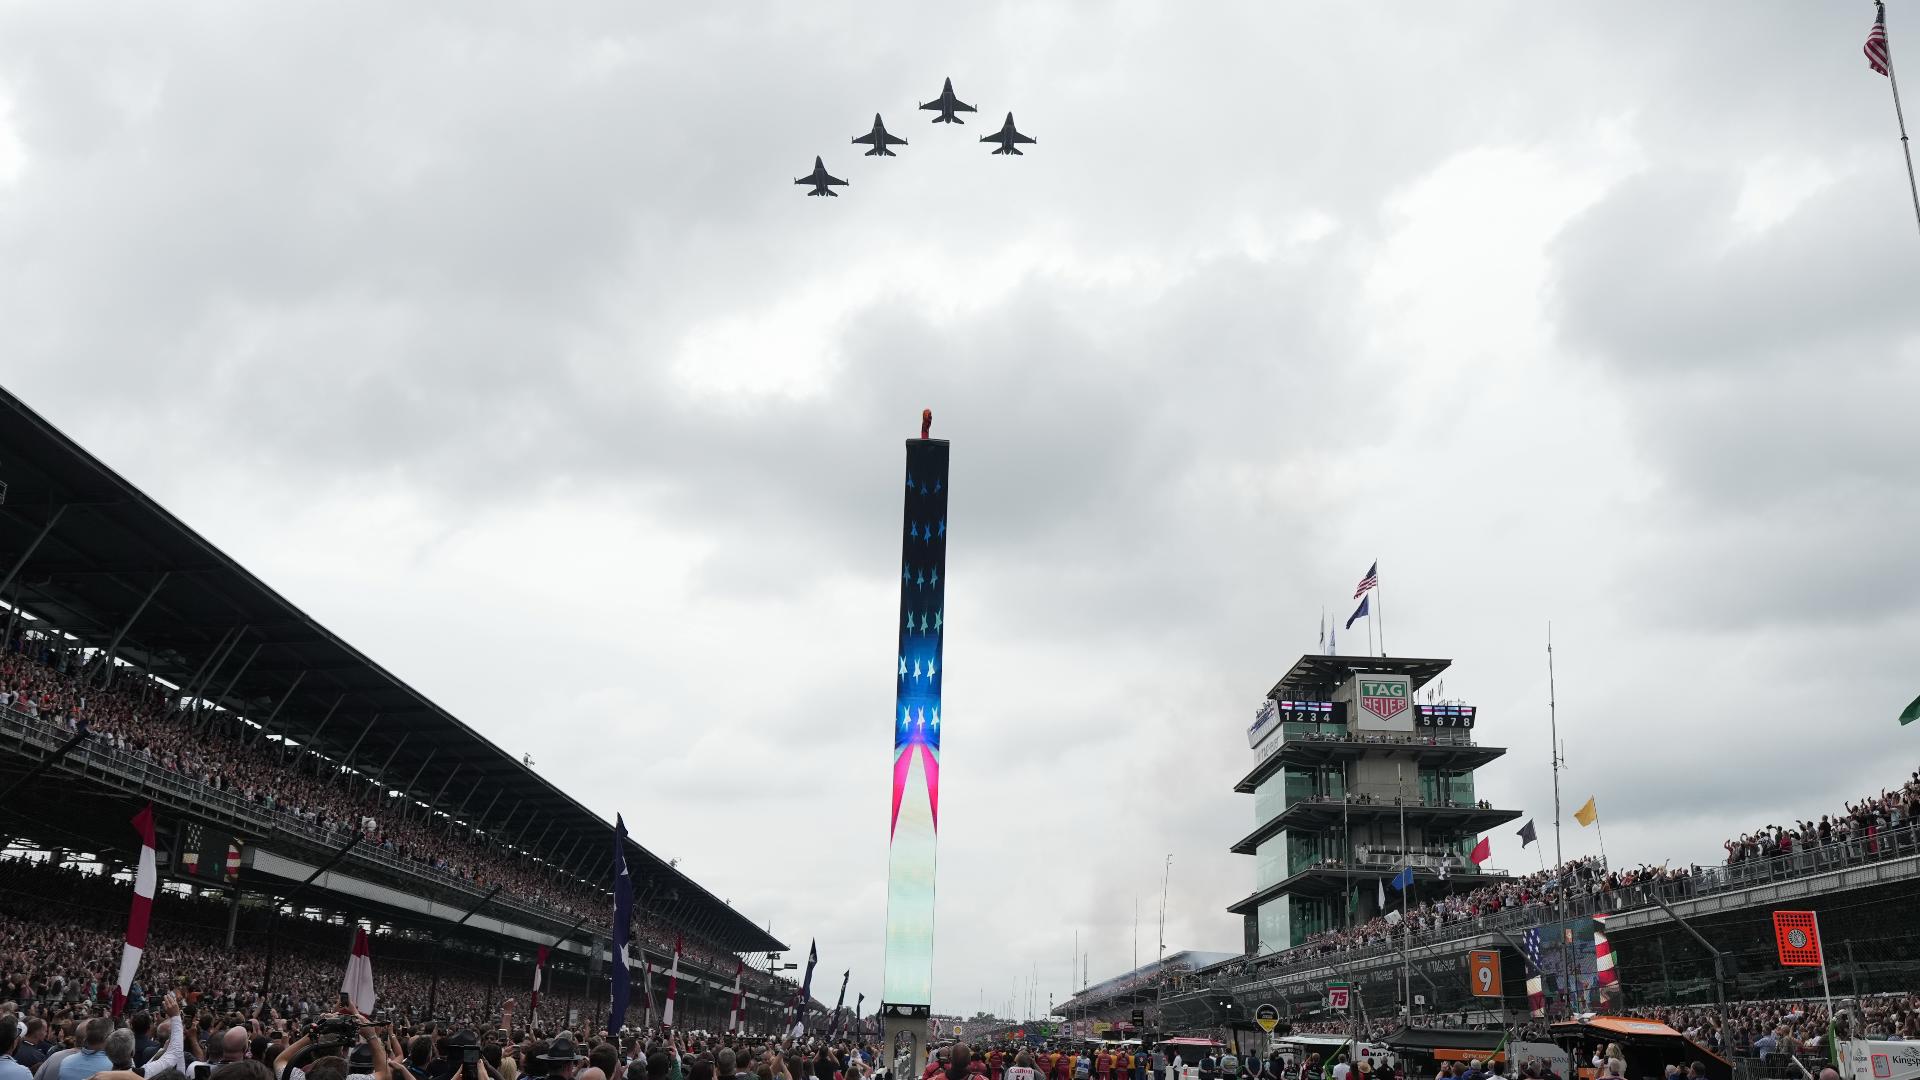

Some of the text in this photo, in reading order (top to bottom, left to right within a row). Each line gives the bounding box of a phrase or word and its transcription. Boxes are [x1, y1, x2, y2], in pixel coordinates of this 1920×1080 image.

[1364, 683, 1403, 697] TAG
[1364, 698, 1405, 717] HEUER
[1284, 712, 1330, 722] 1 2 3 4
[1423, 716, 1470, 727] 5 6 7 8
[1479, 967, 1492, 992] 9
[1331, 991, 1348, 1006] 75
